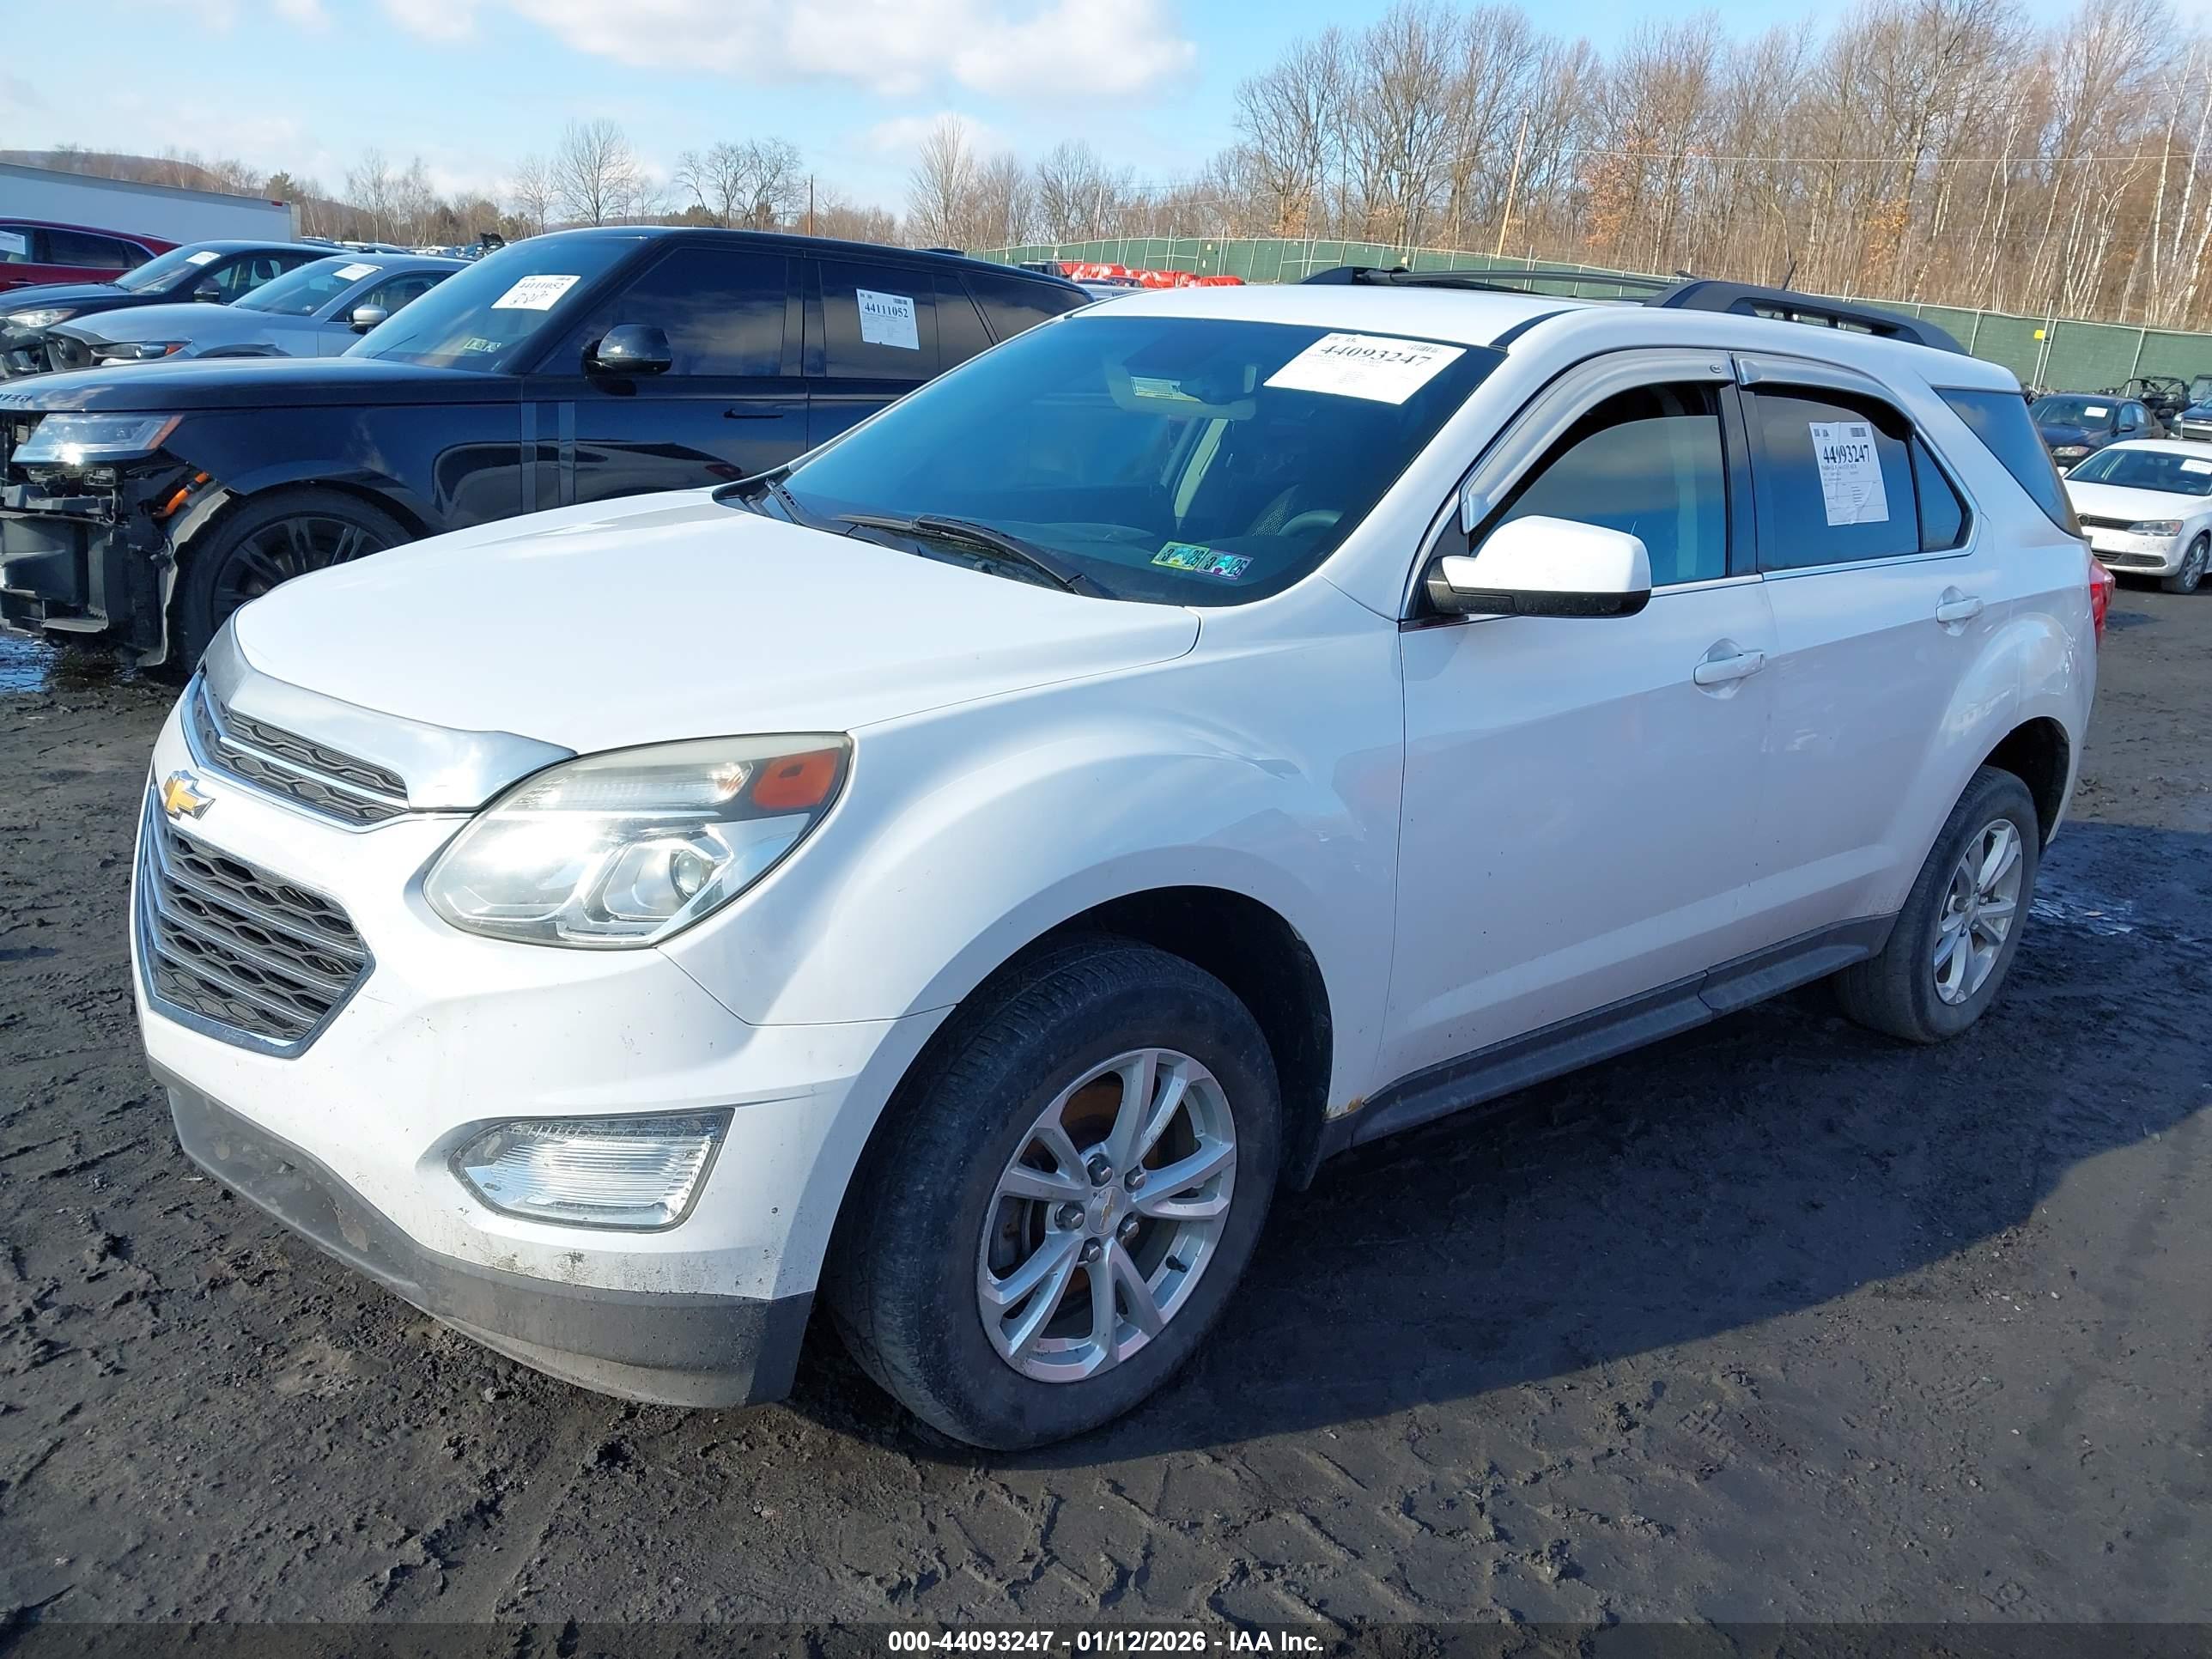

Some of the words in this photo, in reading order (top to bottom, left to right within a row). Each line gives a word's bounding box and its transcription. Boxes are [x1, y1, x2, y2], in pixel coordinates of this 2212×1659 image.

[864, 301, 908, 318] 44111052
[1321, 344, 1431, 366] 44093247
[1161, 548, 1175, 562] 3
[1203, 556, 1217, 570] 3
[1227, 558, 1248, 575] 26
